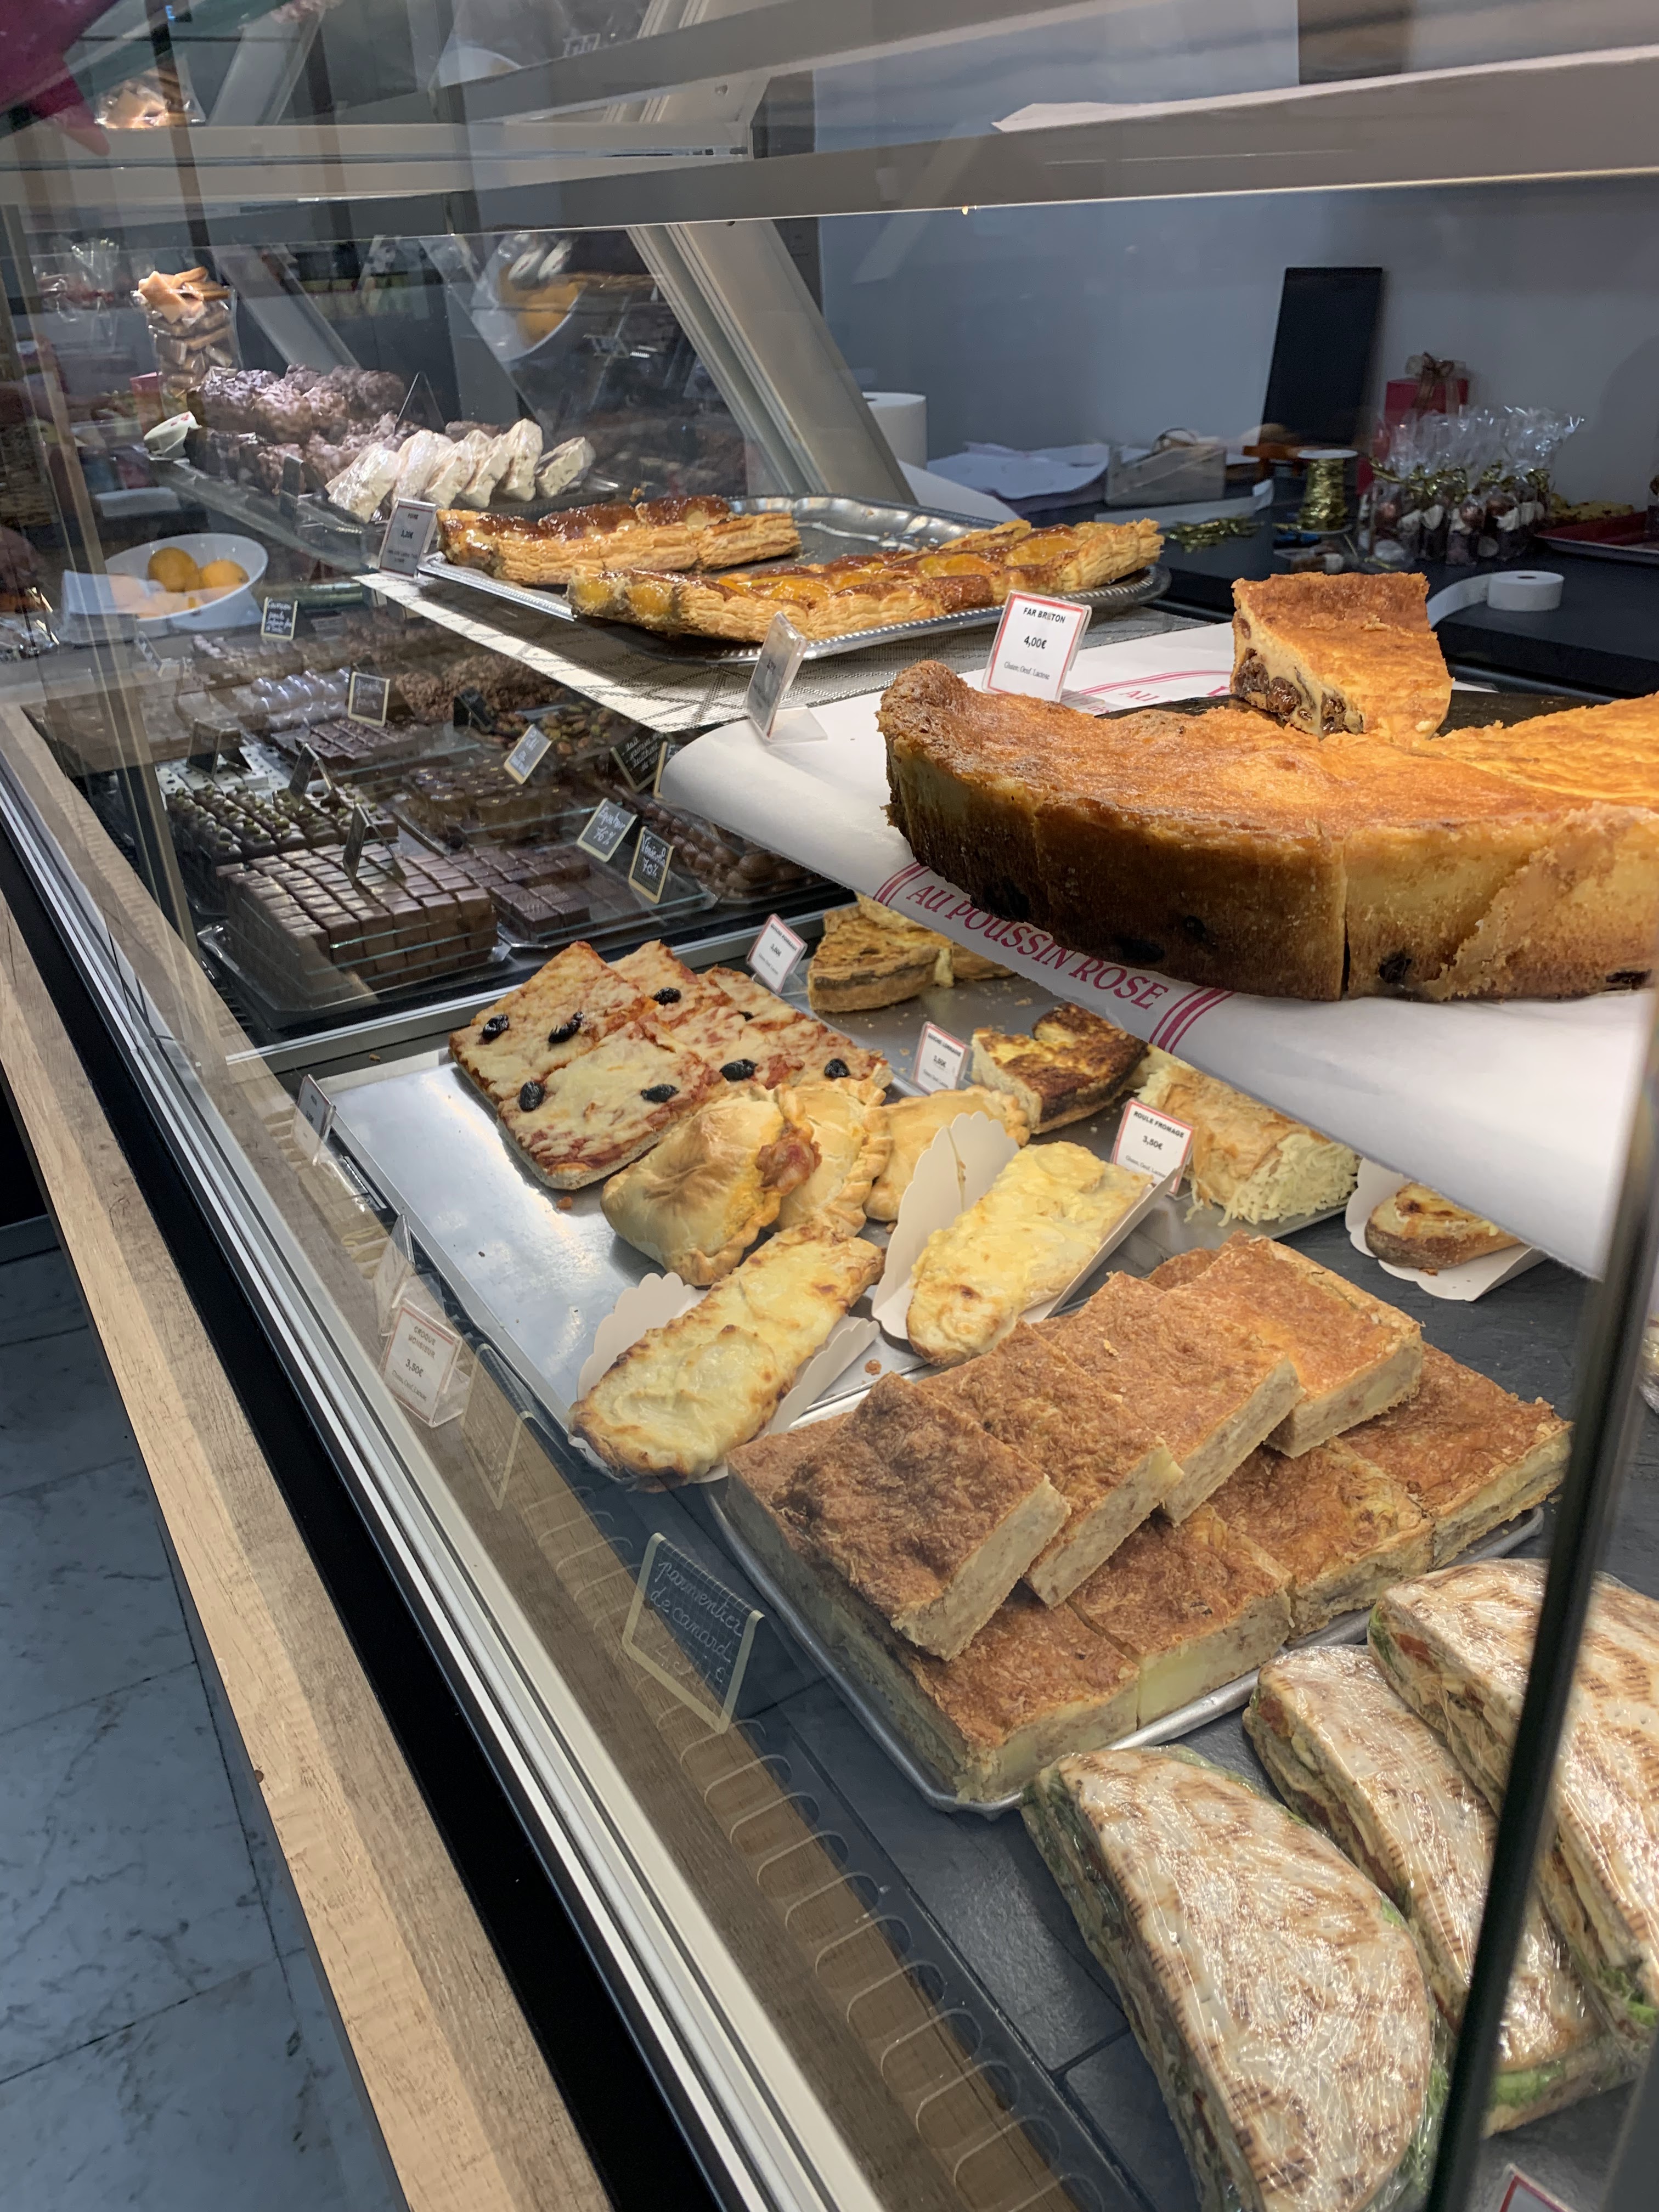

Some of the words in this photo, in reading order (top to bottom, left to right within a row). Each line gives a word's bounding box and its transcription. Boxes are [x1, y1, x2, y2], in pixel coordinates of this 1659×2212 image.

[1023, 607, 1036, 618] FAR
[1037, 611, 1066, 623] BRETON
[1023, 635, 1047, 649] 4,00€
[642, 857, 659, 877] 70%
[906, 885, 956, 912] AU
[945, 900, 1077, 969] POUSSIN
[1068, 957, 1169, 1009] ROSE
[1133, 1110, 1154, 1124] ROULE
[1154, 1121, 1184, 1138] FROMAGE
[1142, 1135, 1164, 1150] 3,50€
[414, 1325, 436, 1346] CROQUE
[408, 1334, 436, 1359] MONSIEUR
[405, 1358, 424, 1378] 3,50€
[650, 1587, 671, 1613] de
[673, 1607, 731, 1663] canard
